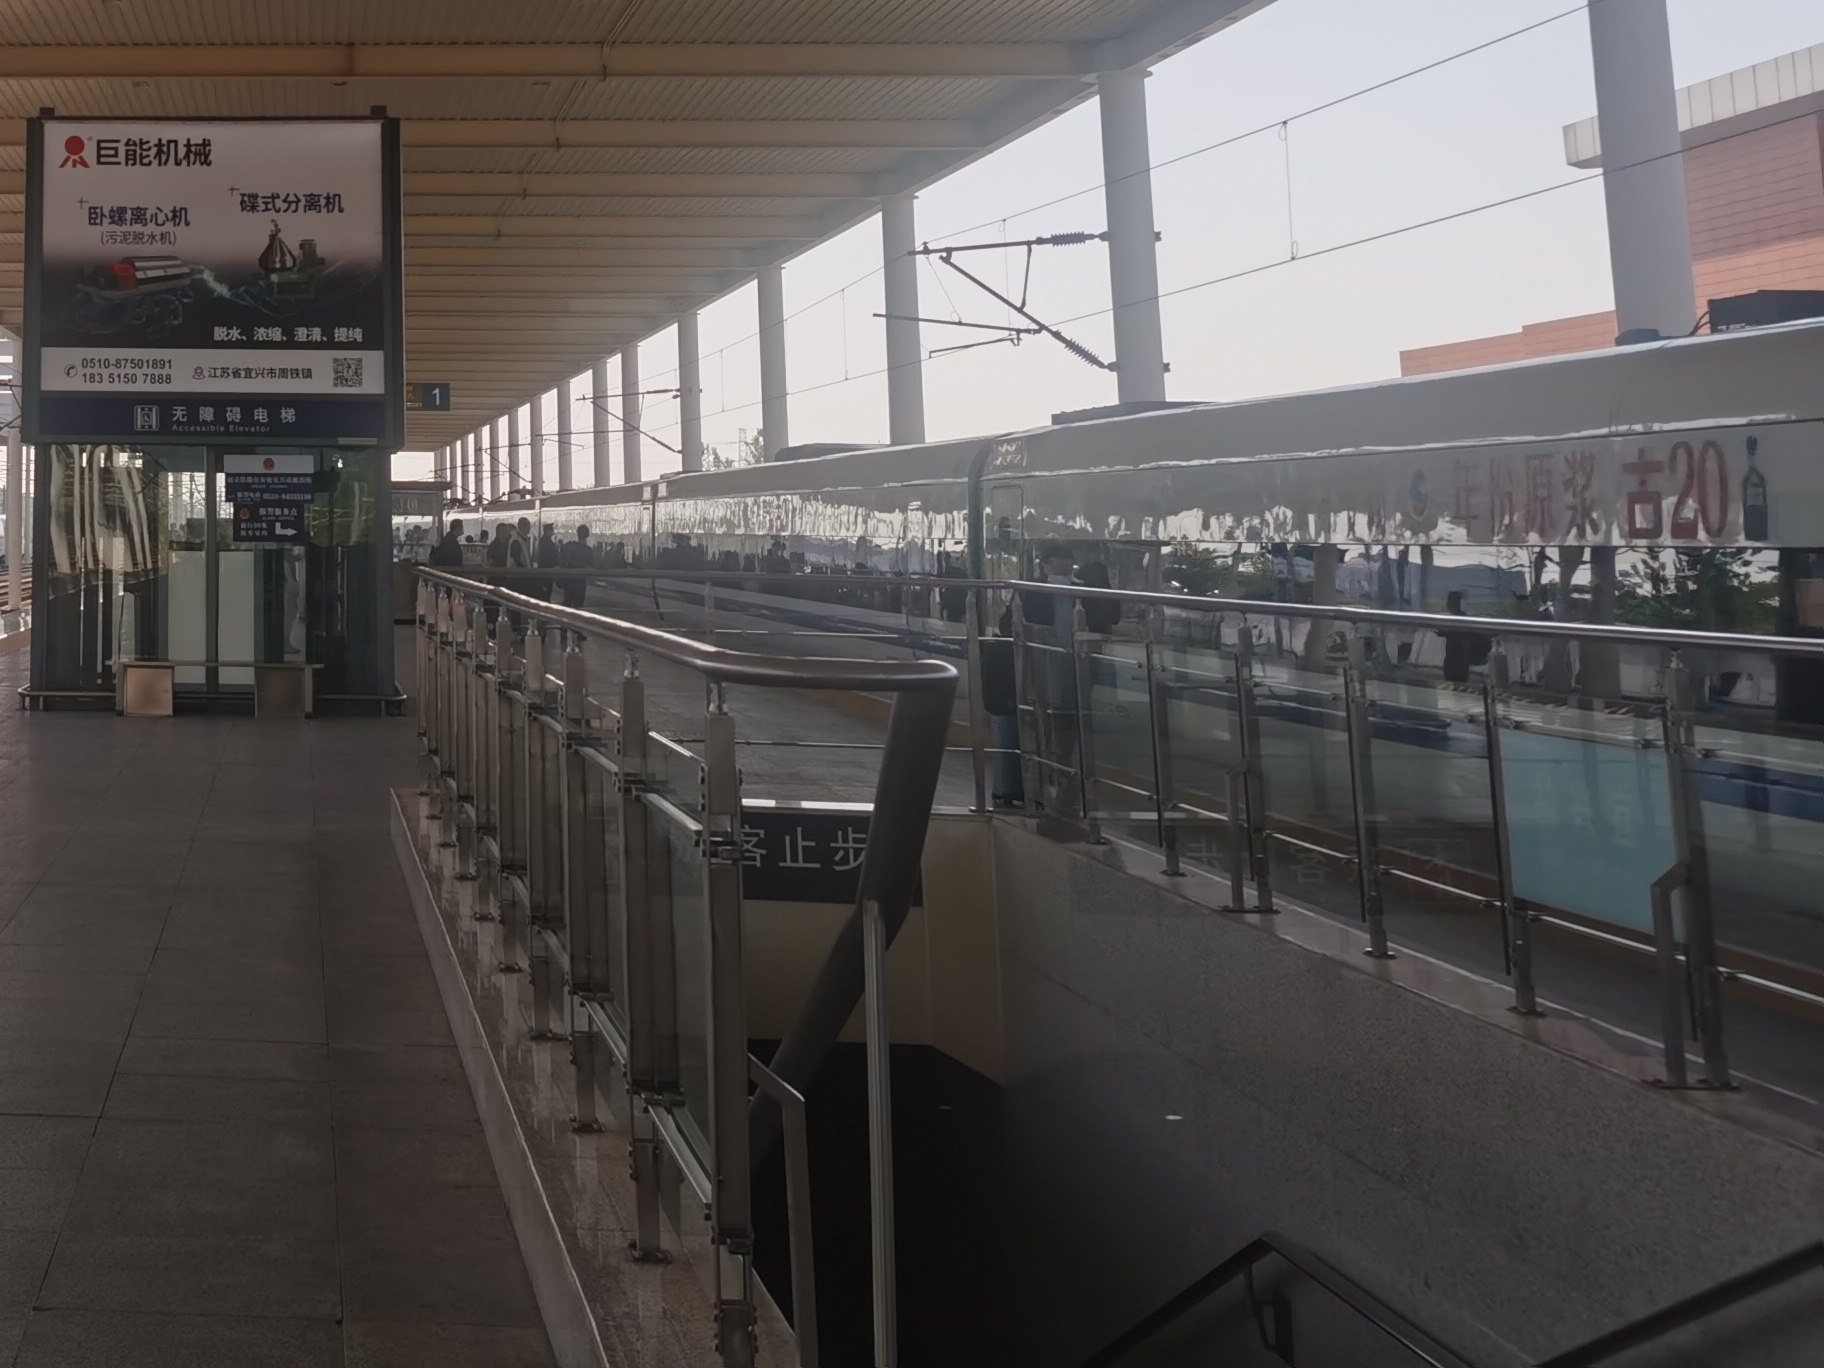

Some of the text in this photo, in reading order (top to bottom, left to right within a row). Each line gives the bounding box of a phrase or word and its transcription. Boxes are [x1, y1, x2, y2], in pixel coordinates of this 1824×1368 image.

[95, 137, 213, 168] 巨能机械
[239, 192, 345, 215] 碟式分离机
[87, 205, 191, 228] 卧螺离心机
[81, 357, 173, 370] 0510-87501891
[81, 372, 172, 385] 183 5150 7888
[207, 366, 313, 381] 江苏省宜兴市周铁镇
[431, 387, 440, 406] 1
[171, 405, 297, 424] 无障碍电梯
[229, 424, 271, 433] Elevator
